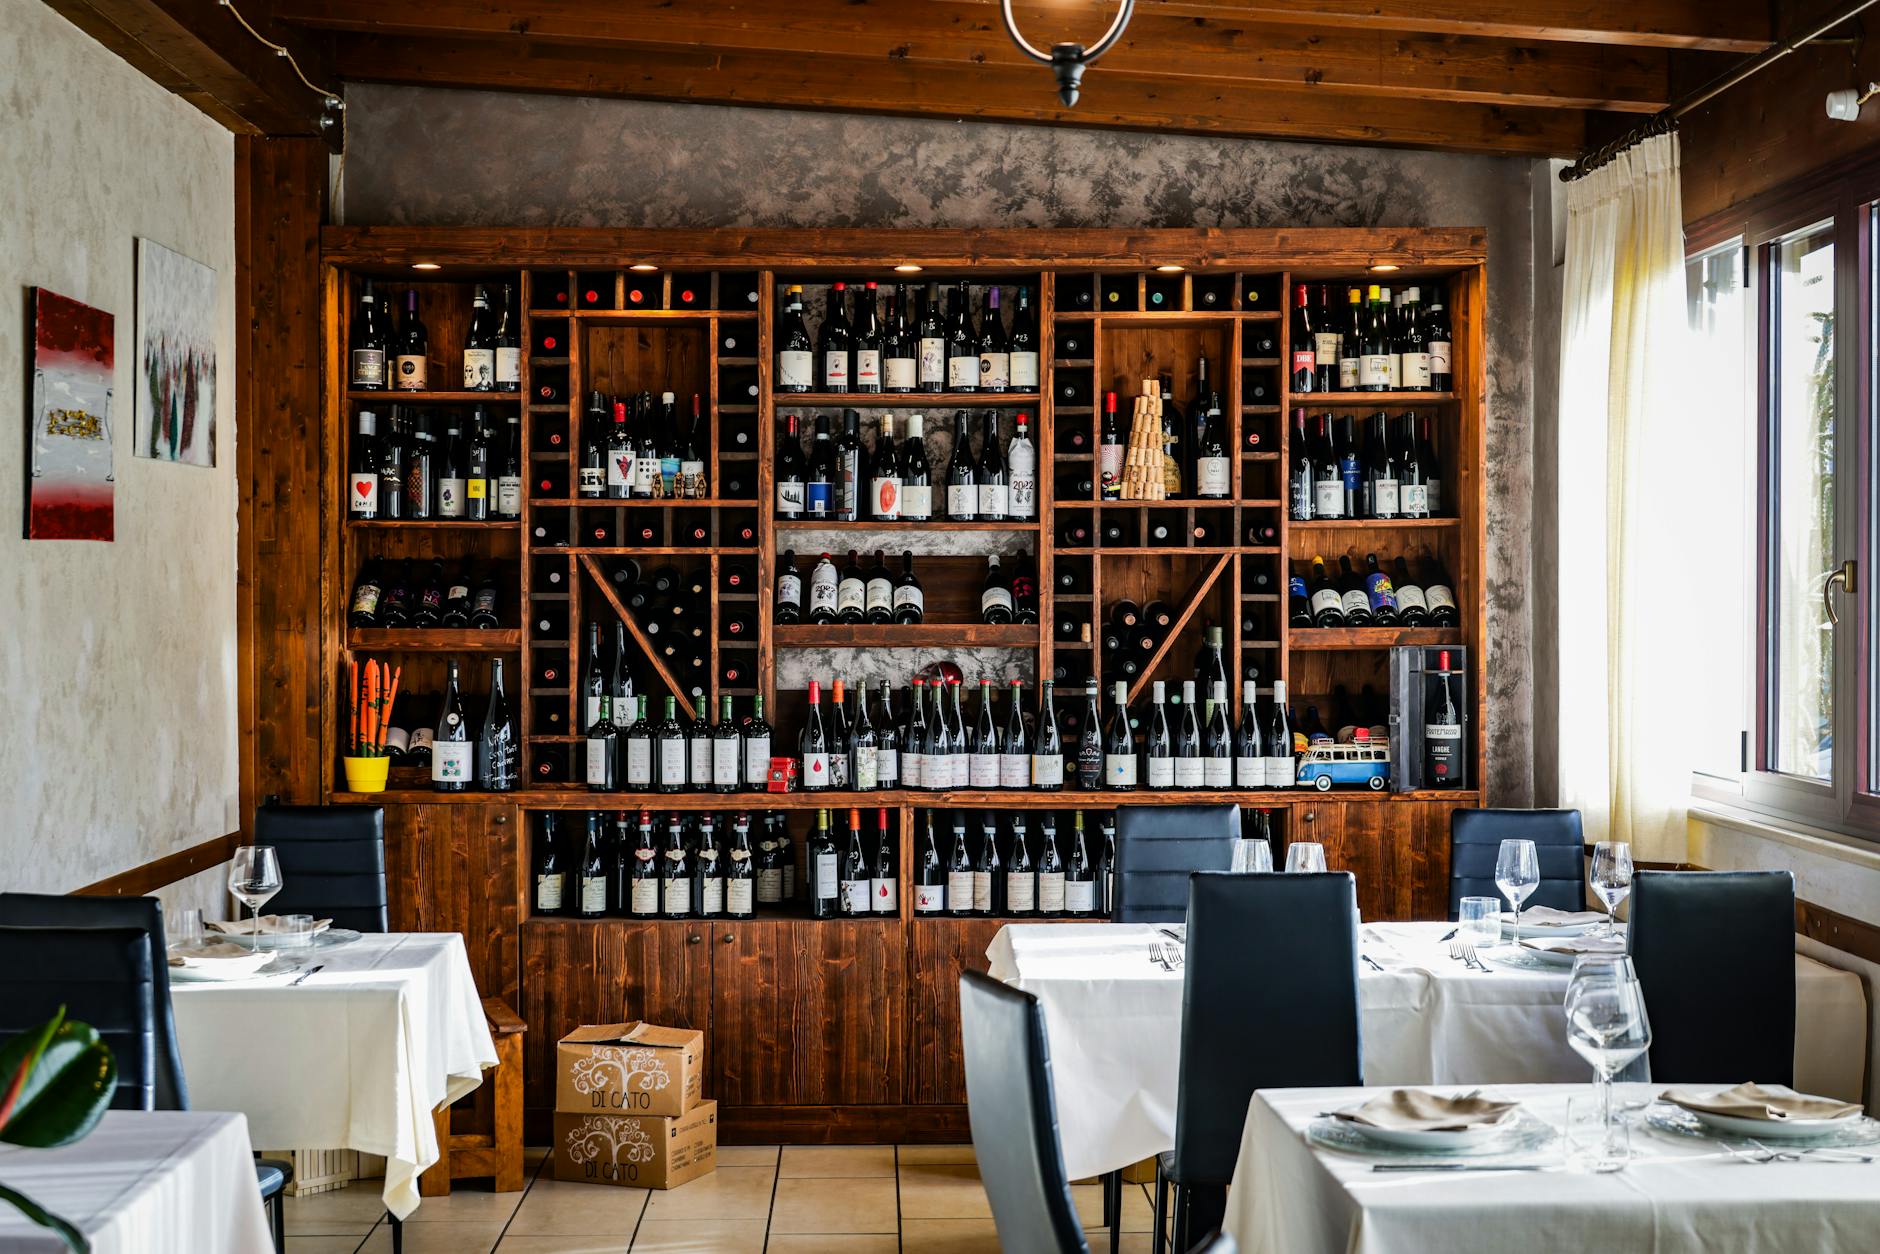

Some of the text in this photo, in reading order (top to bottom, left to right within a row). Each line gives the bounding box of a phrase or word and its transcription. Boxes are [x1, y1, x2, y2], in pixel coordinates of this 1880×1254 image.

[1013, 481, 1034, 490] 2022
[592, 1091, 650, 1109] DI CATO
[585, 1161, 638, 1181] DI CATO
